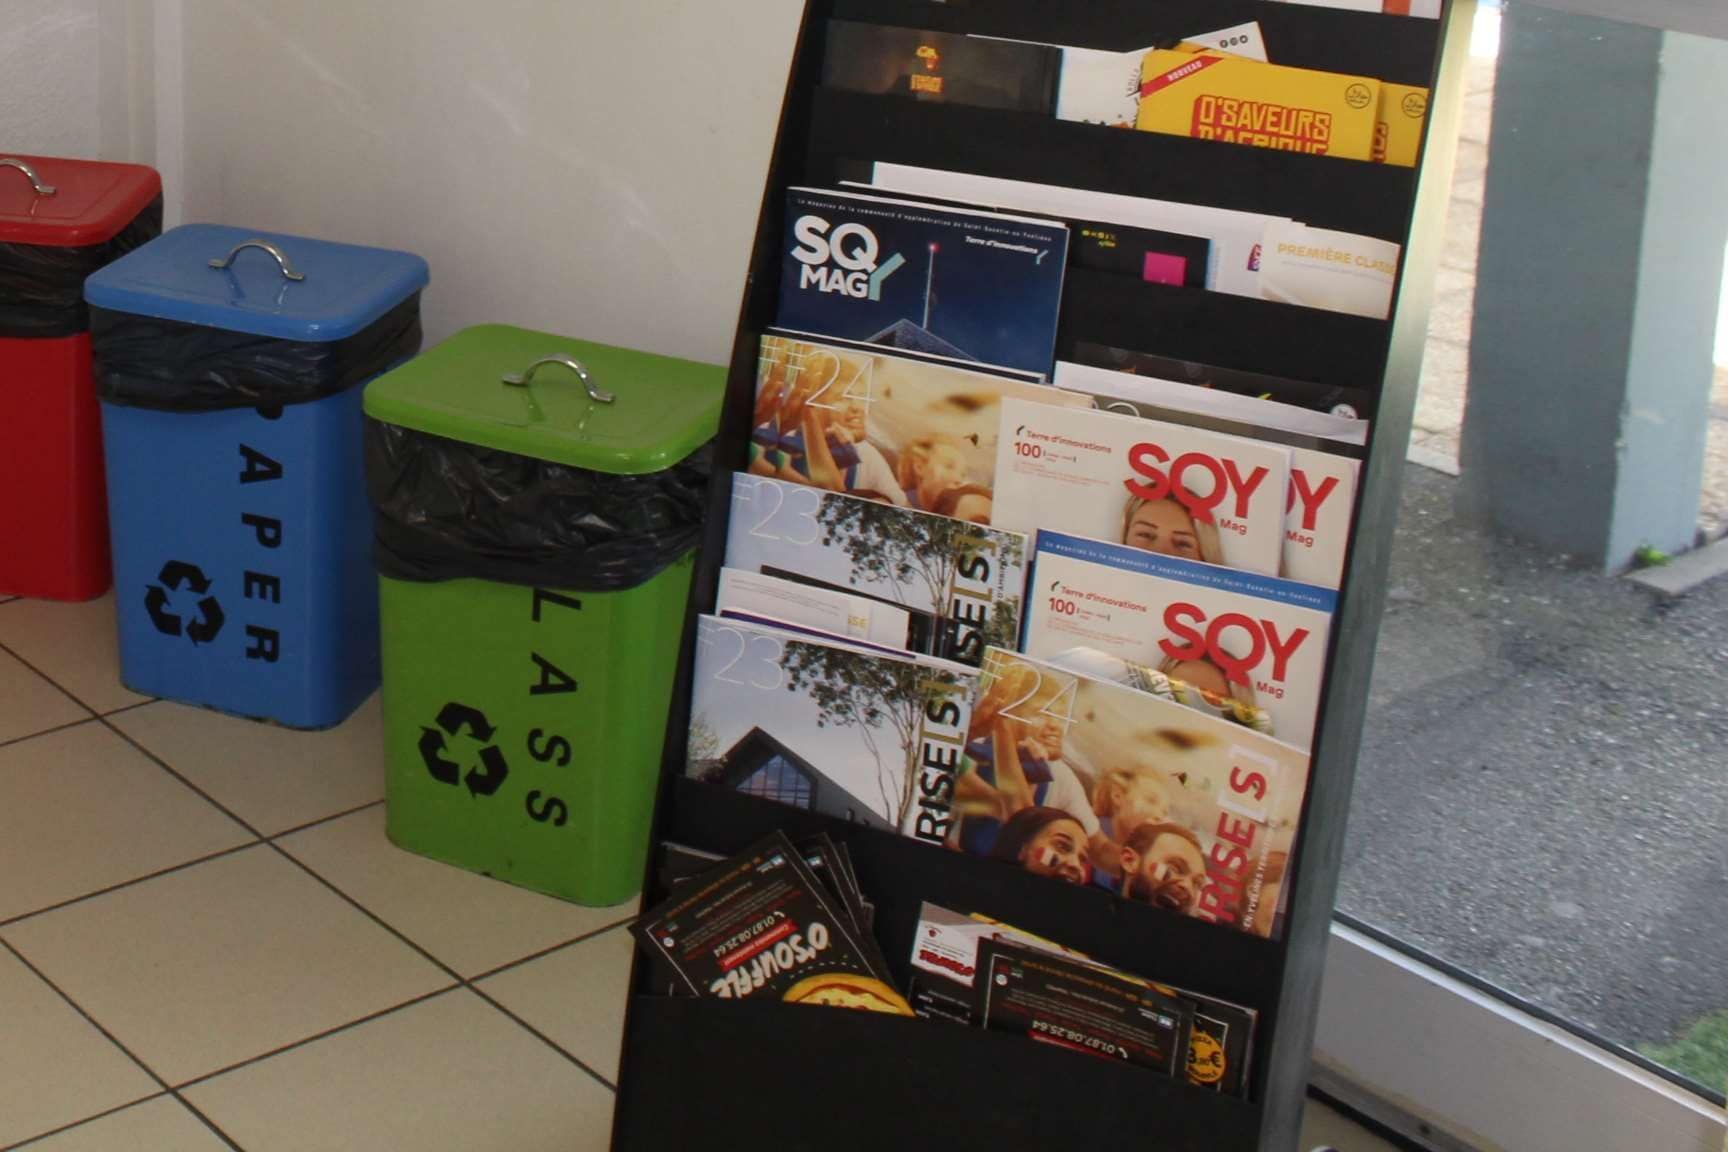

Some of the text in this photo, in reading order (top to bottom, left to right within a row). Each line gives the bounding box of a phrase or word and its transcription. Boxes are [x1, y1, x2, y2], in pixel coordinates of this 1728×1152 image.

[1168, 60, 1203, 81] NOUVEAU
[1199, 96, 1331, 141] O'SAVEURS
[1277, 242, 1353, 264] PREMIÈRE
[799, 263, 870, 298] MAG
[1014, 441, 1041, 458] 100
[1123, 442, 1270, 526] SQY
[239, 406, 284, 663] APER
[1219, 517, 1248, 535] Mag
[1286, 529, 1315, 547] Mag
[1061, 585, 1084, 598] Terre
[1048, 597, 1075, 616] 100
[1158, 602, 1310, 688] SQY
[1257, 680, 1285, 699] Mag
[525, 587, 582, 827] LASS
[1032, 1018, 1116, 1055] 01.87.08.25.64
